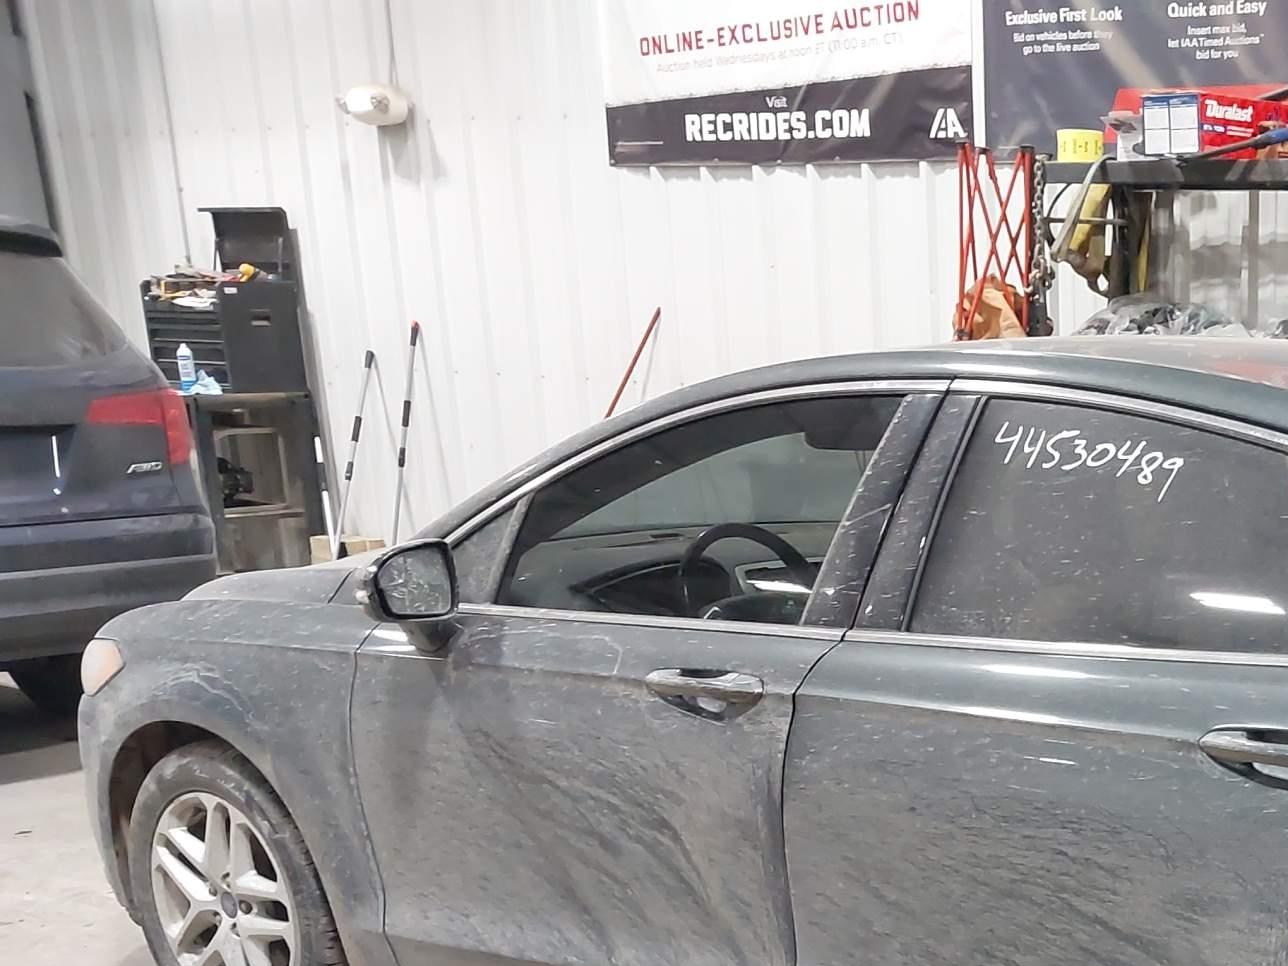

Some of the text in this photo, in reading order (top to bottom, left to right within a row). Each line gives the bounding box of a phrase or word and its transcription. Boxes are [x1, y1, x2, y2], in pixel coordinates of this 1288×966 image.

[1005, 6, 1123, 26] Exclusive First Look
[1167, 0, 1267, 18] Quick and Easy
[640, 0, 919, 56] ONLINE-EXCLUSIVE AUCTION
[1025, 33, 1035, 42] on
[1036, 30, 1067, 41] vehicles
[1068, 29, 1092, 40] before
[1187, 25, 1211, 35] Insert
[1212, 26, 1230, 34] max
[1023, 41, 1100, 56] go to the live auction
[1195, 48, 1239, 60] bid for you
[765, 96, 788, 108] Visit
[1205, 99, 1253, 122] Duralast
[685, 108, 871, 142] RECRIDES.COM
[994, 421, 1185, 502] 44530489
